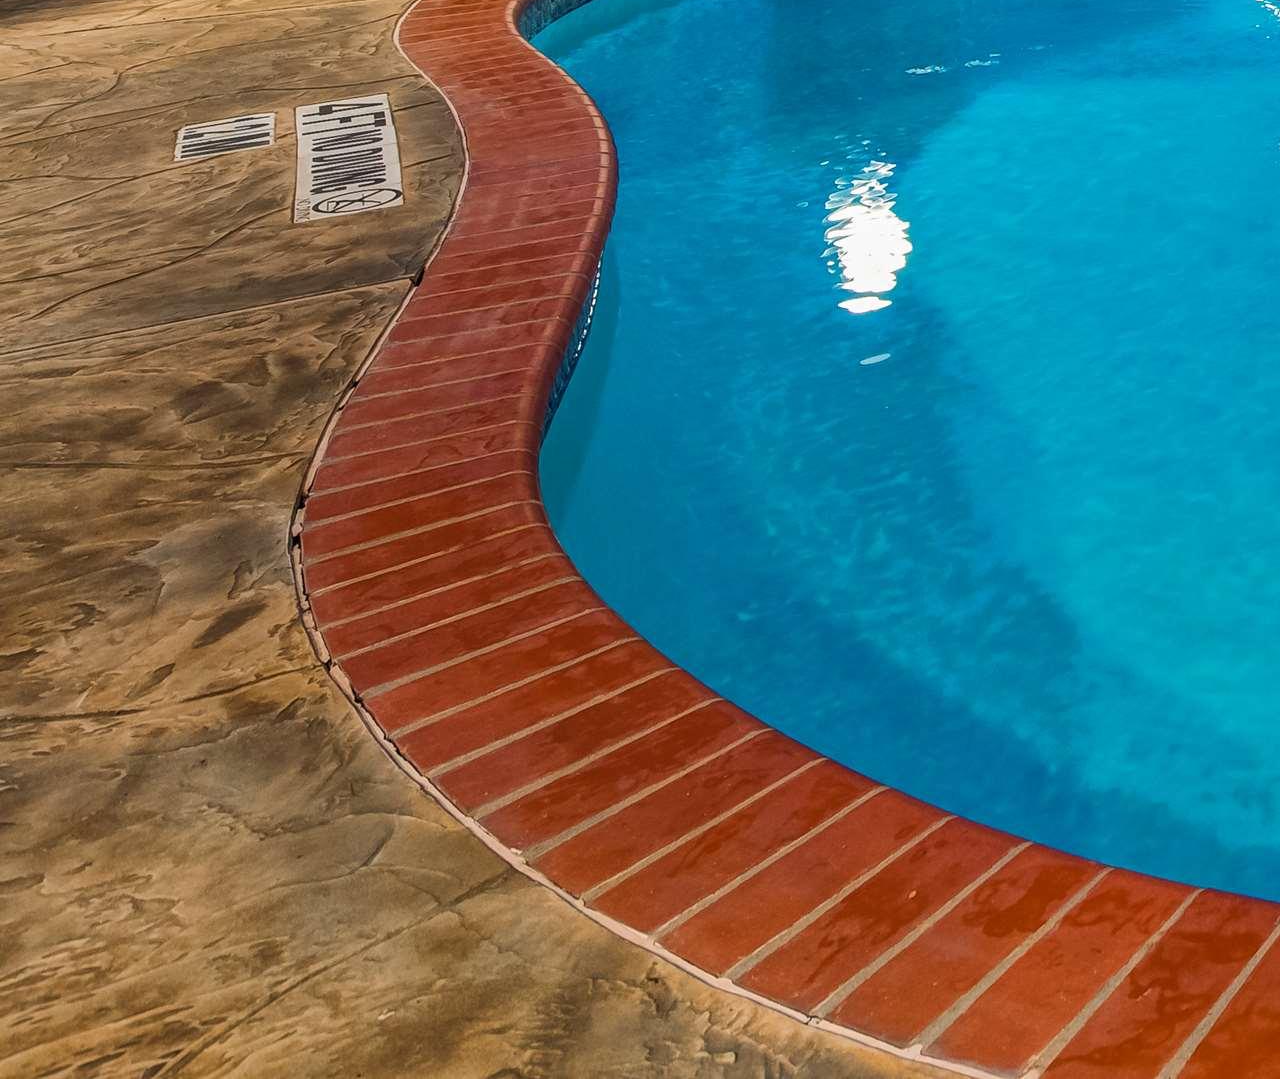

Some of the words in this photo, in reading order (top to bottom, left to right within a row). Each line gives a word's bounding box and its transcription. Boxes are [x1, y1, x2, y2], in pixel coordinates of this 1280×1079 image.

[302, 103, 383, 118] 4
[302, 111, 387, 136] FT
[181, 132, 271, 159] M
[311, 129, 384, 152] NO
[310, 147, 387, 196] DIVING
